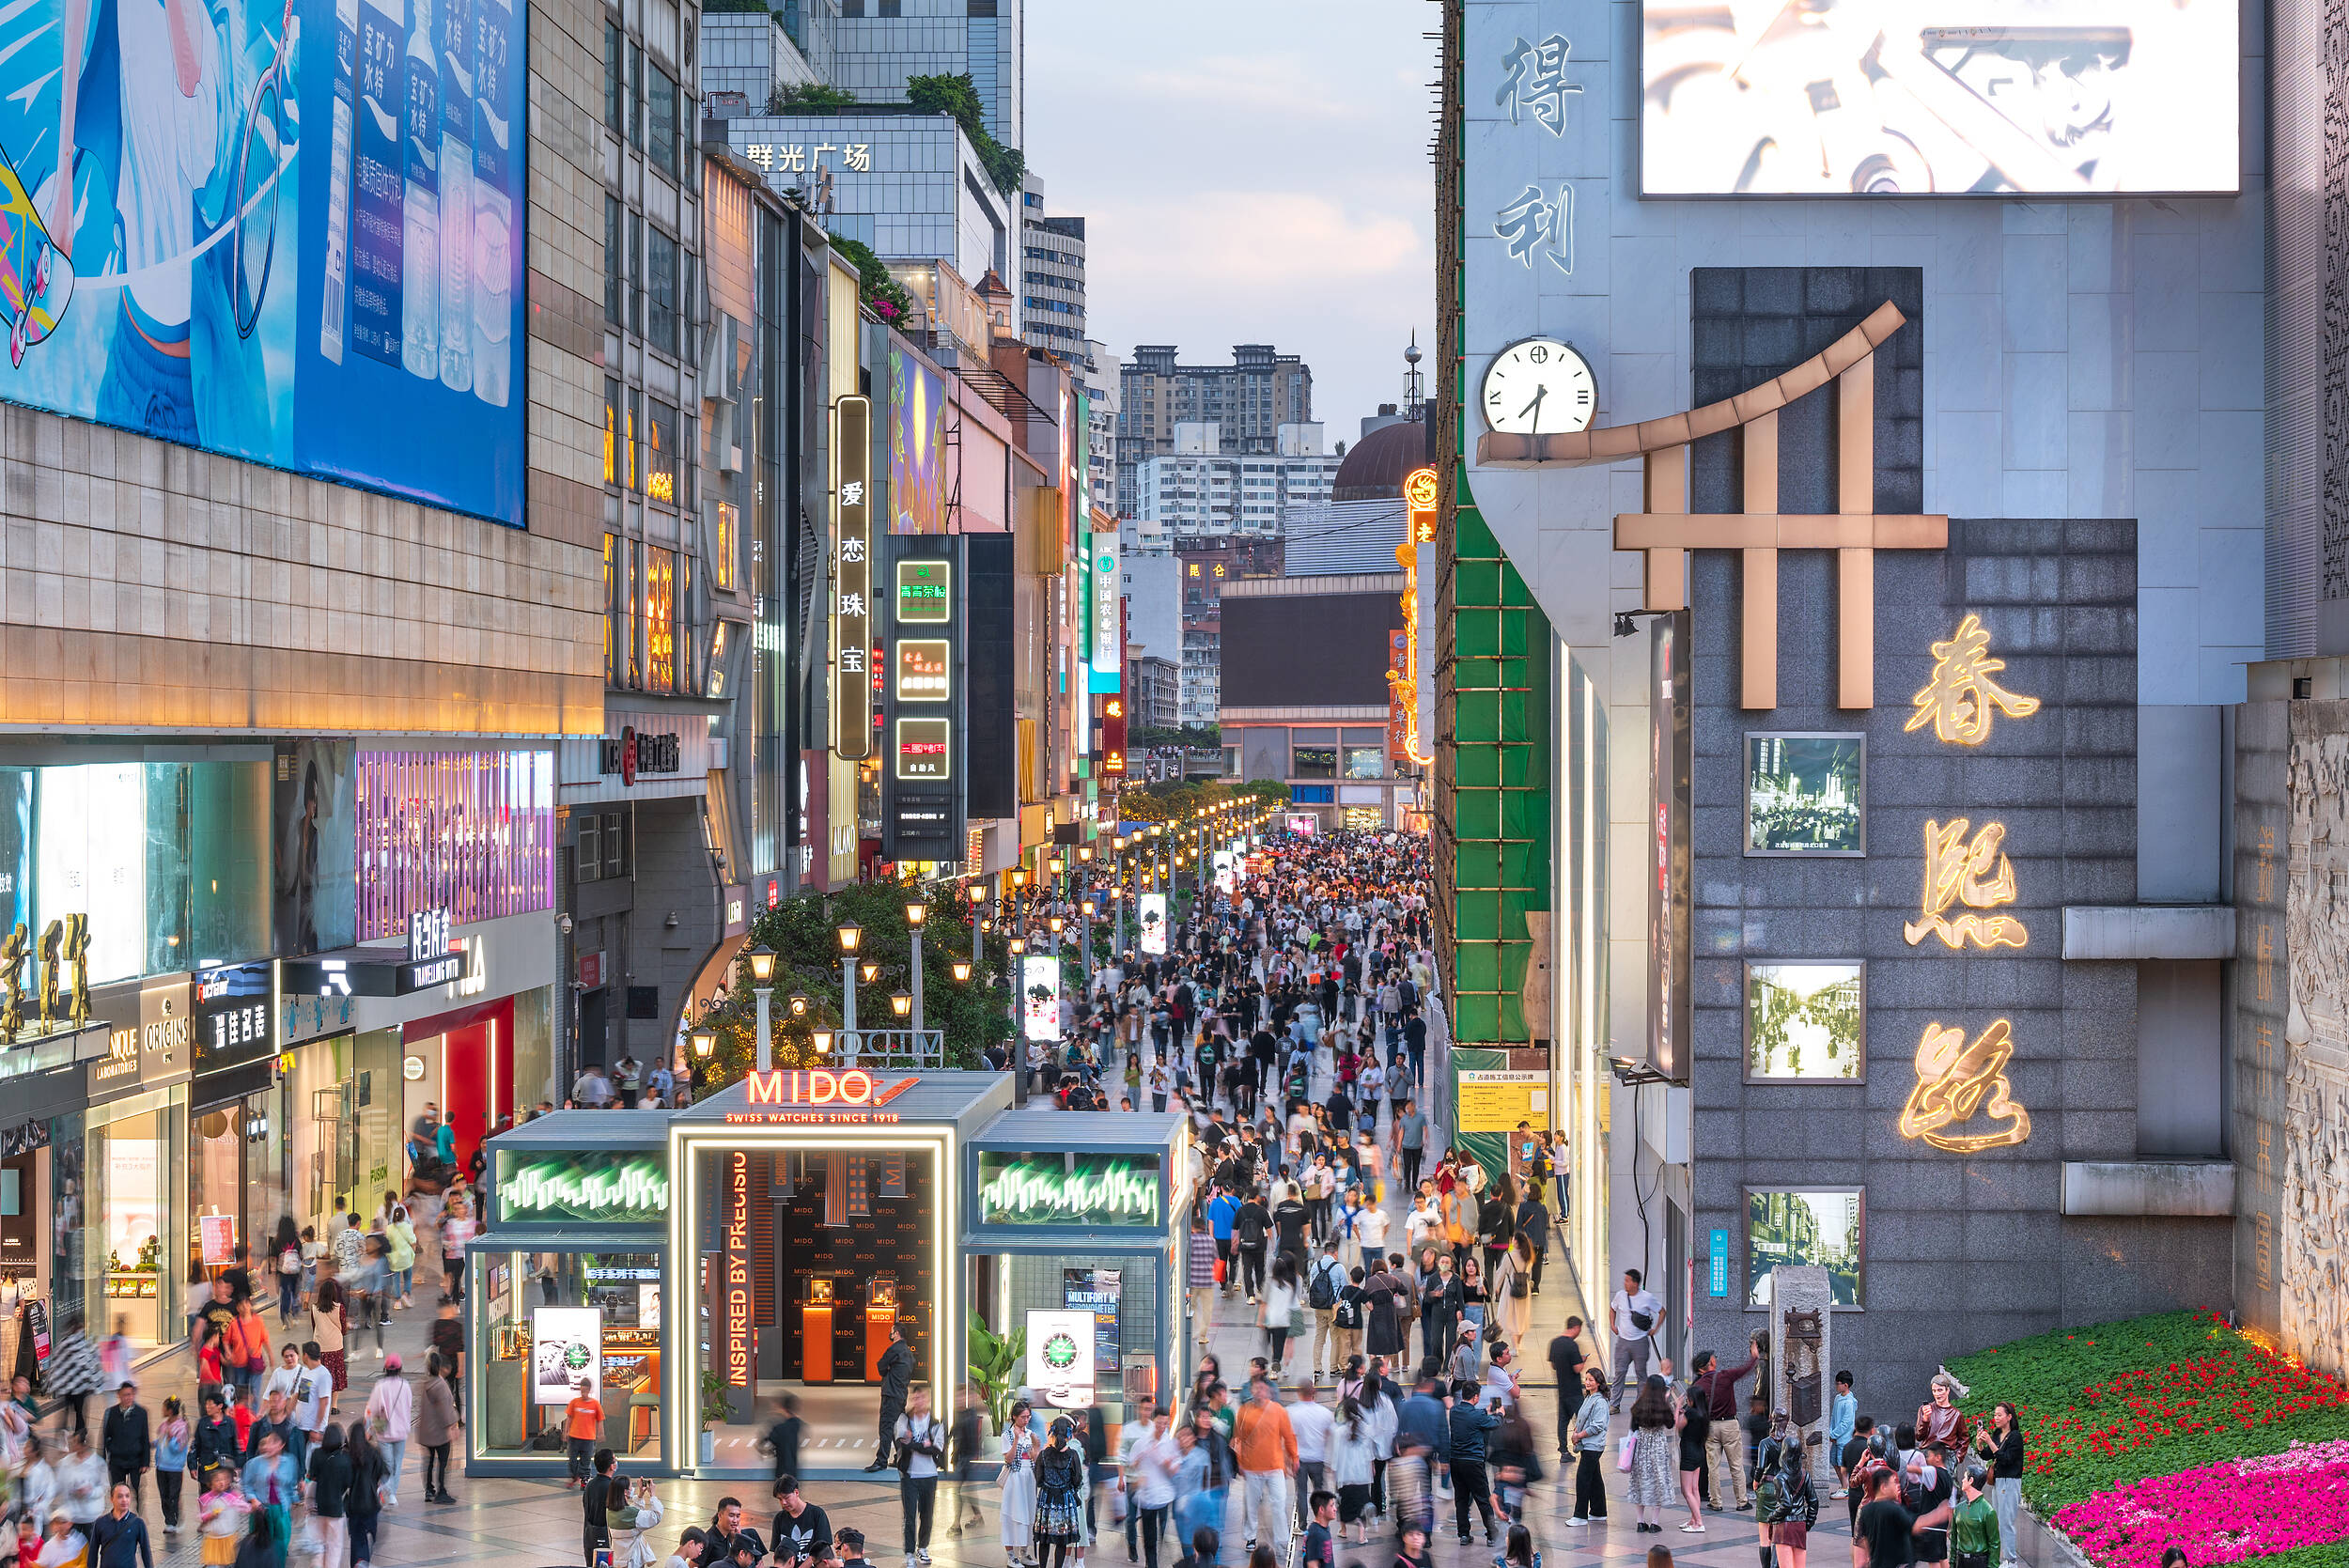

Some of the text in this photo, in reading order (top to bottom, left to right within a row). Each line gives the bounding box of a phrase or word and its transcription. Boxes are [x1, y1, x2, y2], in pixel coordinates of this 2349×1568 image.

[364, 23, 394, 69] 宝矿力
[364, 59, 383, 99] 水特
[411, 73, 435, 113] 宝矿力
[411, 104, 427, 138] 水特
[747, 142, 870, 173] 群光广场
[840, 480, 866, 673] 爱恋珠宝
[1189, 563, 1225, 577] 昆仑
[1099, 574, 1112, 660] 中国农业银行
[1901, 613, 2041, 1153] 春熙路
[144, 1017, 188, 1053] ORIGINS
[214, 1004, 265, 1049] 瑞佳名表
[97, 1060, 138, 1080] LABORATORIES
[748, 1070, 872, 1104] MIDO
[726, 1113, 899, 1123] SWISS WATCHES SINCE 1918
[729, 1254, 747, 1283] BY
[1067, 1292, 1108, 1303] MULTIFORT
[729, 1290, 747, 1386] INSPIRED
